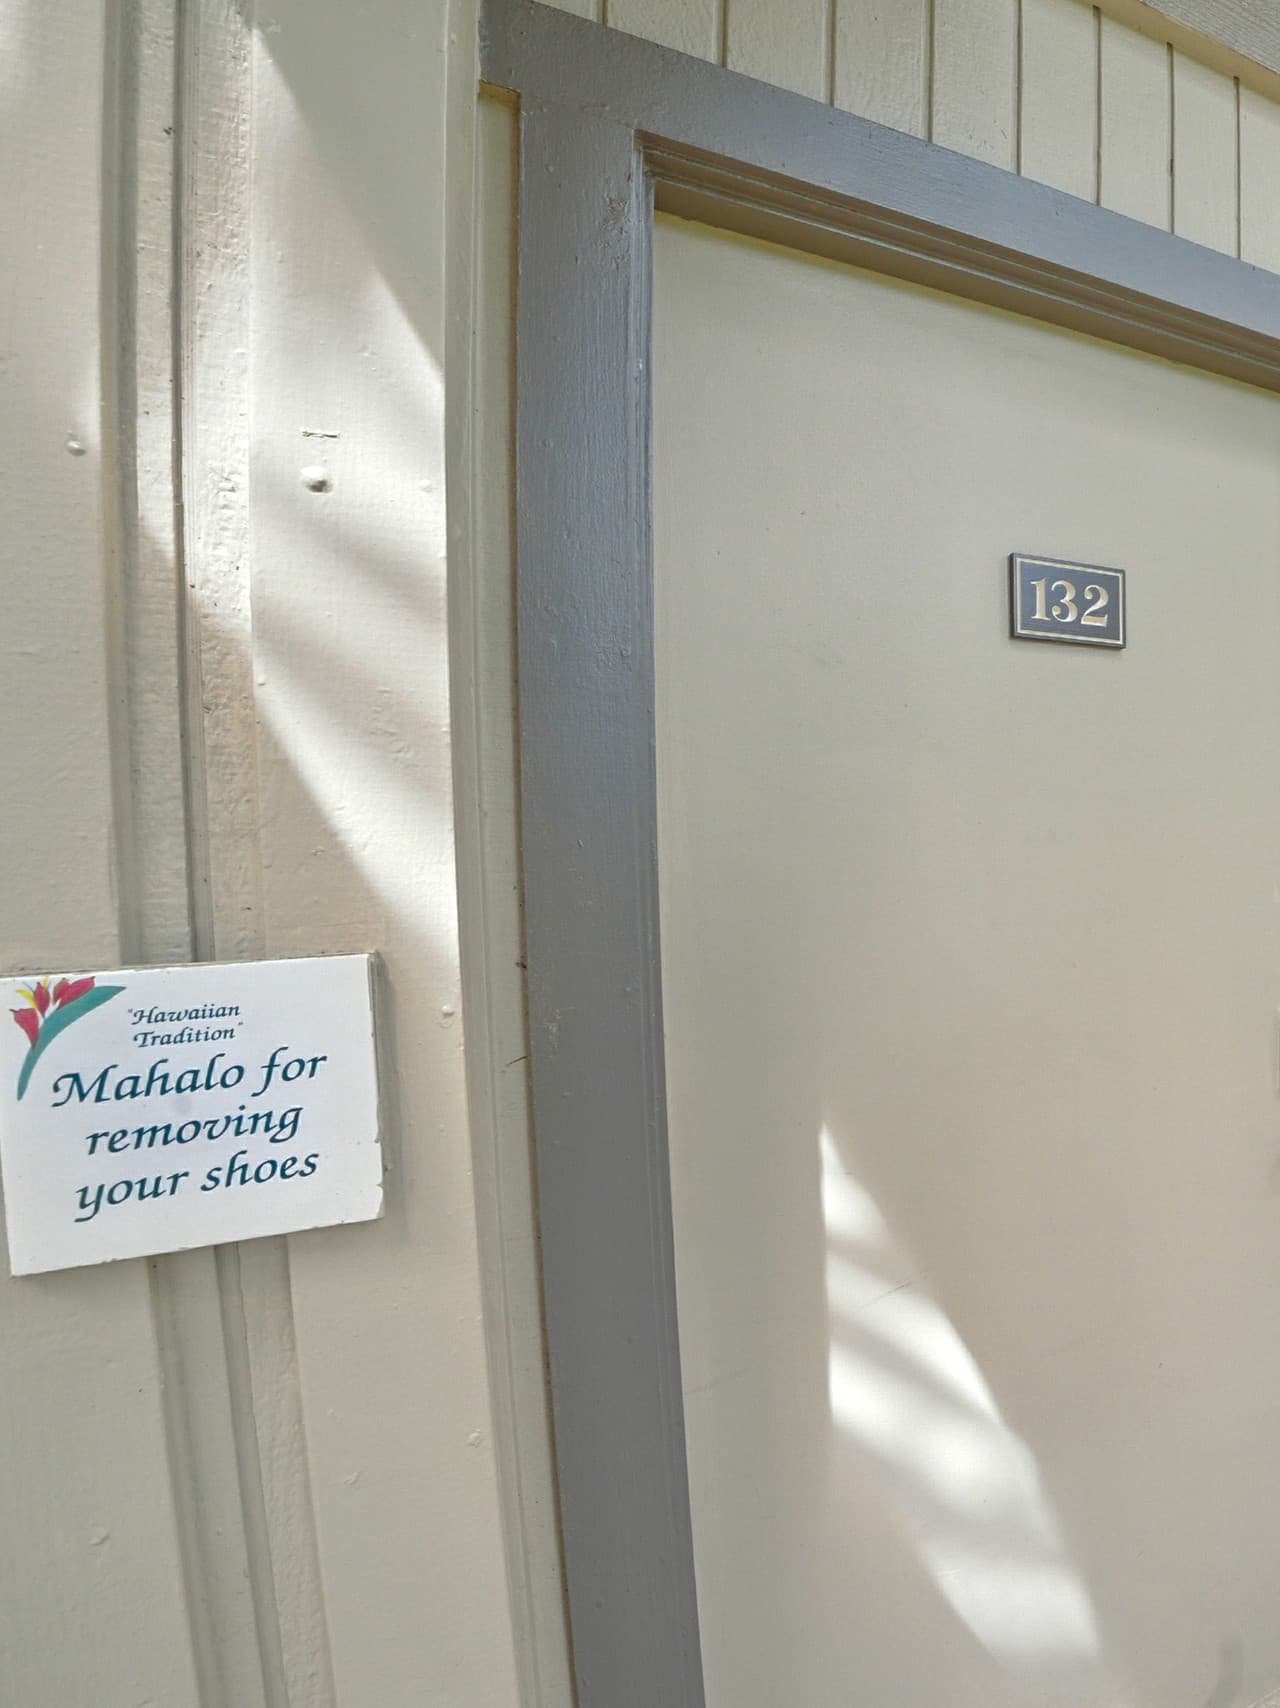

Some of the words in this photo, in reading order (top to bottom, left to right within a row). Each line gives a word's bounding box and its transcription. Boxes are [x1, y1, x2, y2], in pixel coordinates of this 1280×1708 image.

[1030, 577, 1109, 628] 132
[127, 1003, 241, 1026] "Hawaiian
[133, 1022, 244, 1048] Tradition"
[51, 1053, 244, 1107] Mahalo
[251, 1046, 328, 1097] for
[85, 1105, 304, 1156] removing
[74, 1171, 190, 1223] your
[200, 1150, 320, 1193] shoes
